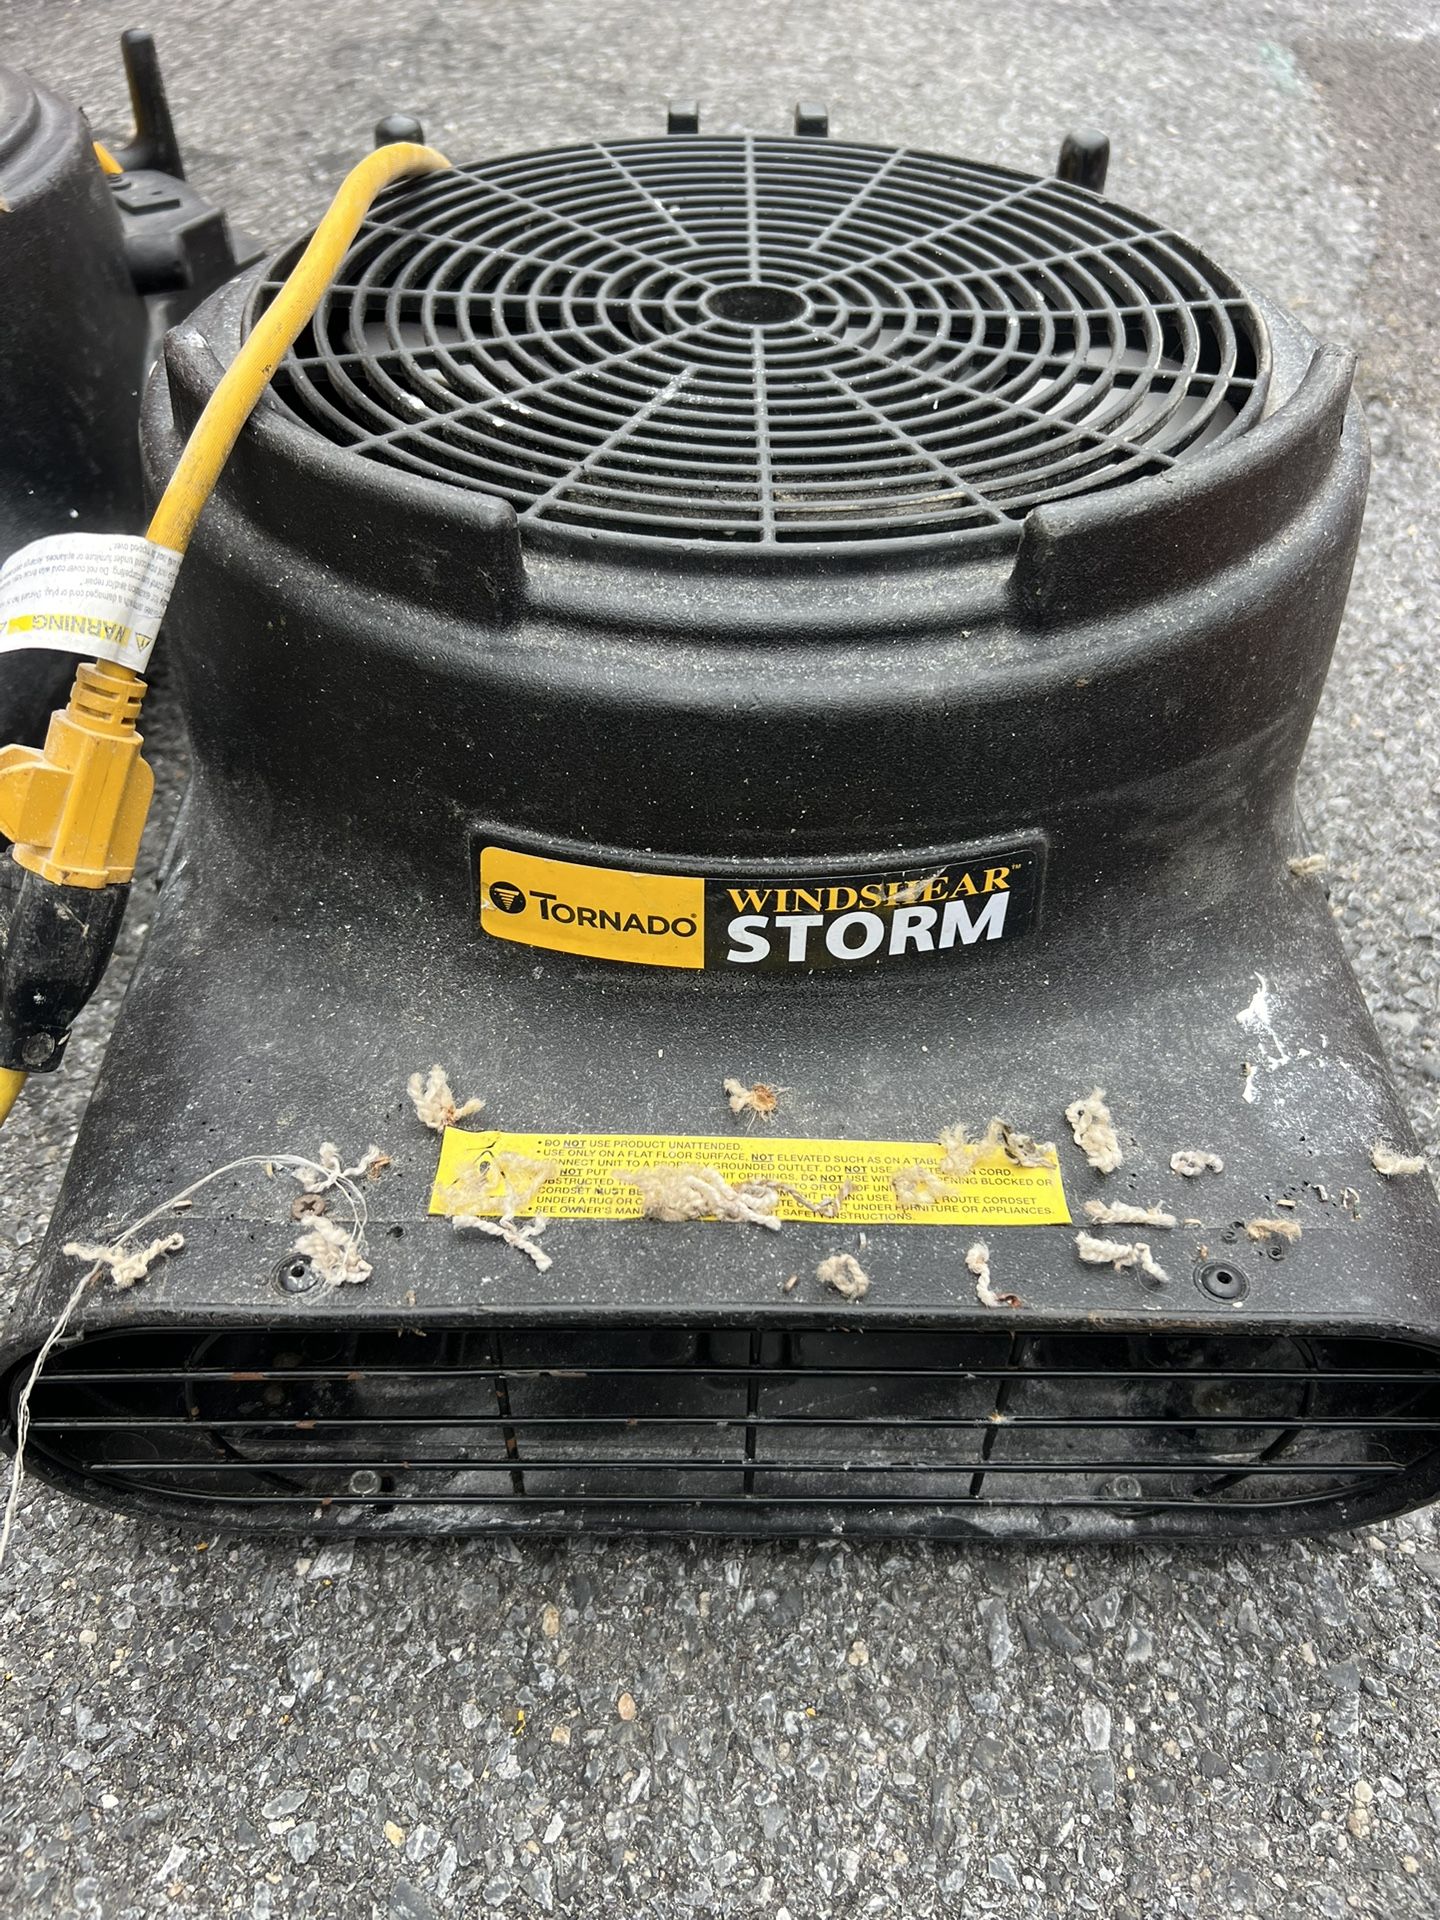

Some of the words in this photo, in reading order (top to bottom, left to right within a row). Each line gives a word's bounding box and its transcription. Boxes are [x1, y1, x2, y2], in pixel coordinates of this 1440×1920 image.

[52, 565, 66, 575] cord
[87, 566, 98, 576] not
[99, 566, 109, 576] Do
[60, 589, 67, 597] or
[69, 589, 84, 599] cord
[86, 590, 117, 603] damaged
[32, 615, 125, 643] WARNING
[529, 889, 697, 938] TORNADO
[726, 890, 1010, 963] STORM
[544, 1139, 560, 1147] DO
[563, 1139, 587, 1148] NOT
[589, 1140, 611, 1148] USE
[613, 1140, 666, 1149] PRODUCT
[668, 1141, 743, 1151] UNATTENDED.
[568, 1149, 596, 1157] ONLY
[617, 1150, 625, 1158] A
[627, 1150, 653, 1158] FLAT
[656, 1151, 692, 1159] FLOOR
[695, 1152, 748, 1161] SURFACE,
[751, 1153, 775, 1162] NOT
[777, 1153, 831, 1163] ELEVATED
[834, 1155, 864, 1163] SUCH
[867, 1156, 882, 1164] AS
[884, 1156, 900, 1164] ON
[903, 1157, 911, 1165] A
[912, 1157, 943, 1166] TABL
[597, 1159, 621, 1167] UNIT
[713, 1162, 775, 1171] GROUNDED
[778, 1164, 823, 1172] OUTLET.
[844, 1165, 868, 1174] NOT
[870, 1166, 893, 1174] USE
[979, 1168, 1015, 1177] CORD.
[560, 1168, 582, 1176] NOT
[820, 1174, 844, 1183] NOT
[981, 1178, 1034, 1186] BLOCKED
[1036, 1178, 1053, 1187] OR
[811, 1183, 827, 1191] OR
[857, 1184, 871, 1192] OF
[873, 1185, 893, 1193] UNI
[538, 1187, 590, 1195] CORDSET
[594, 1187, 626, 1196] MUST
[628, 1188, 643, 1196] BE
[942, 1195, 981, 1203] ROUTE
[983, 1196, 1038, 1205] CORDSET
[536, 1196, 576, 1204] UNDER
[852, 1203, 892, 1211] UNDER
[895, 1204, 959, 1213] FURNITURE
[962, 1205, 979, 1213] OR
[559, 1206, 612, 1214] OWNER'S
